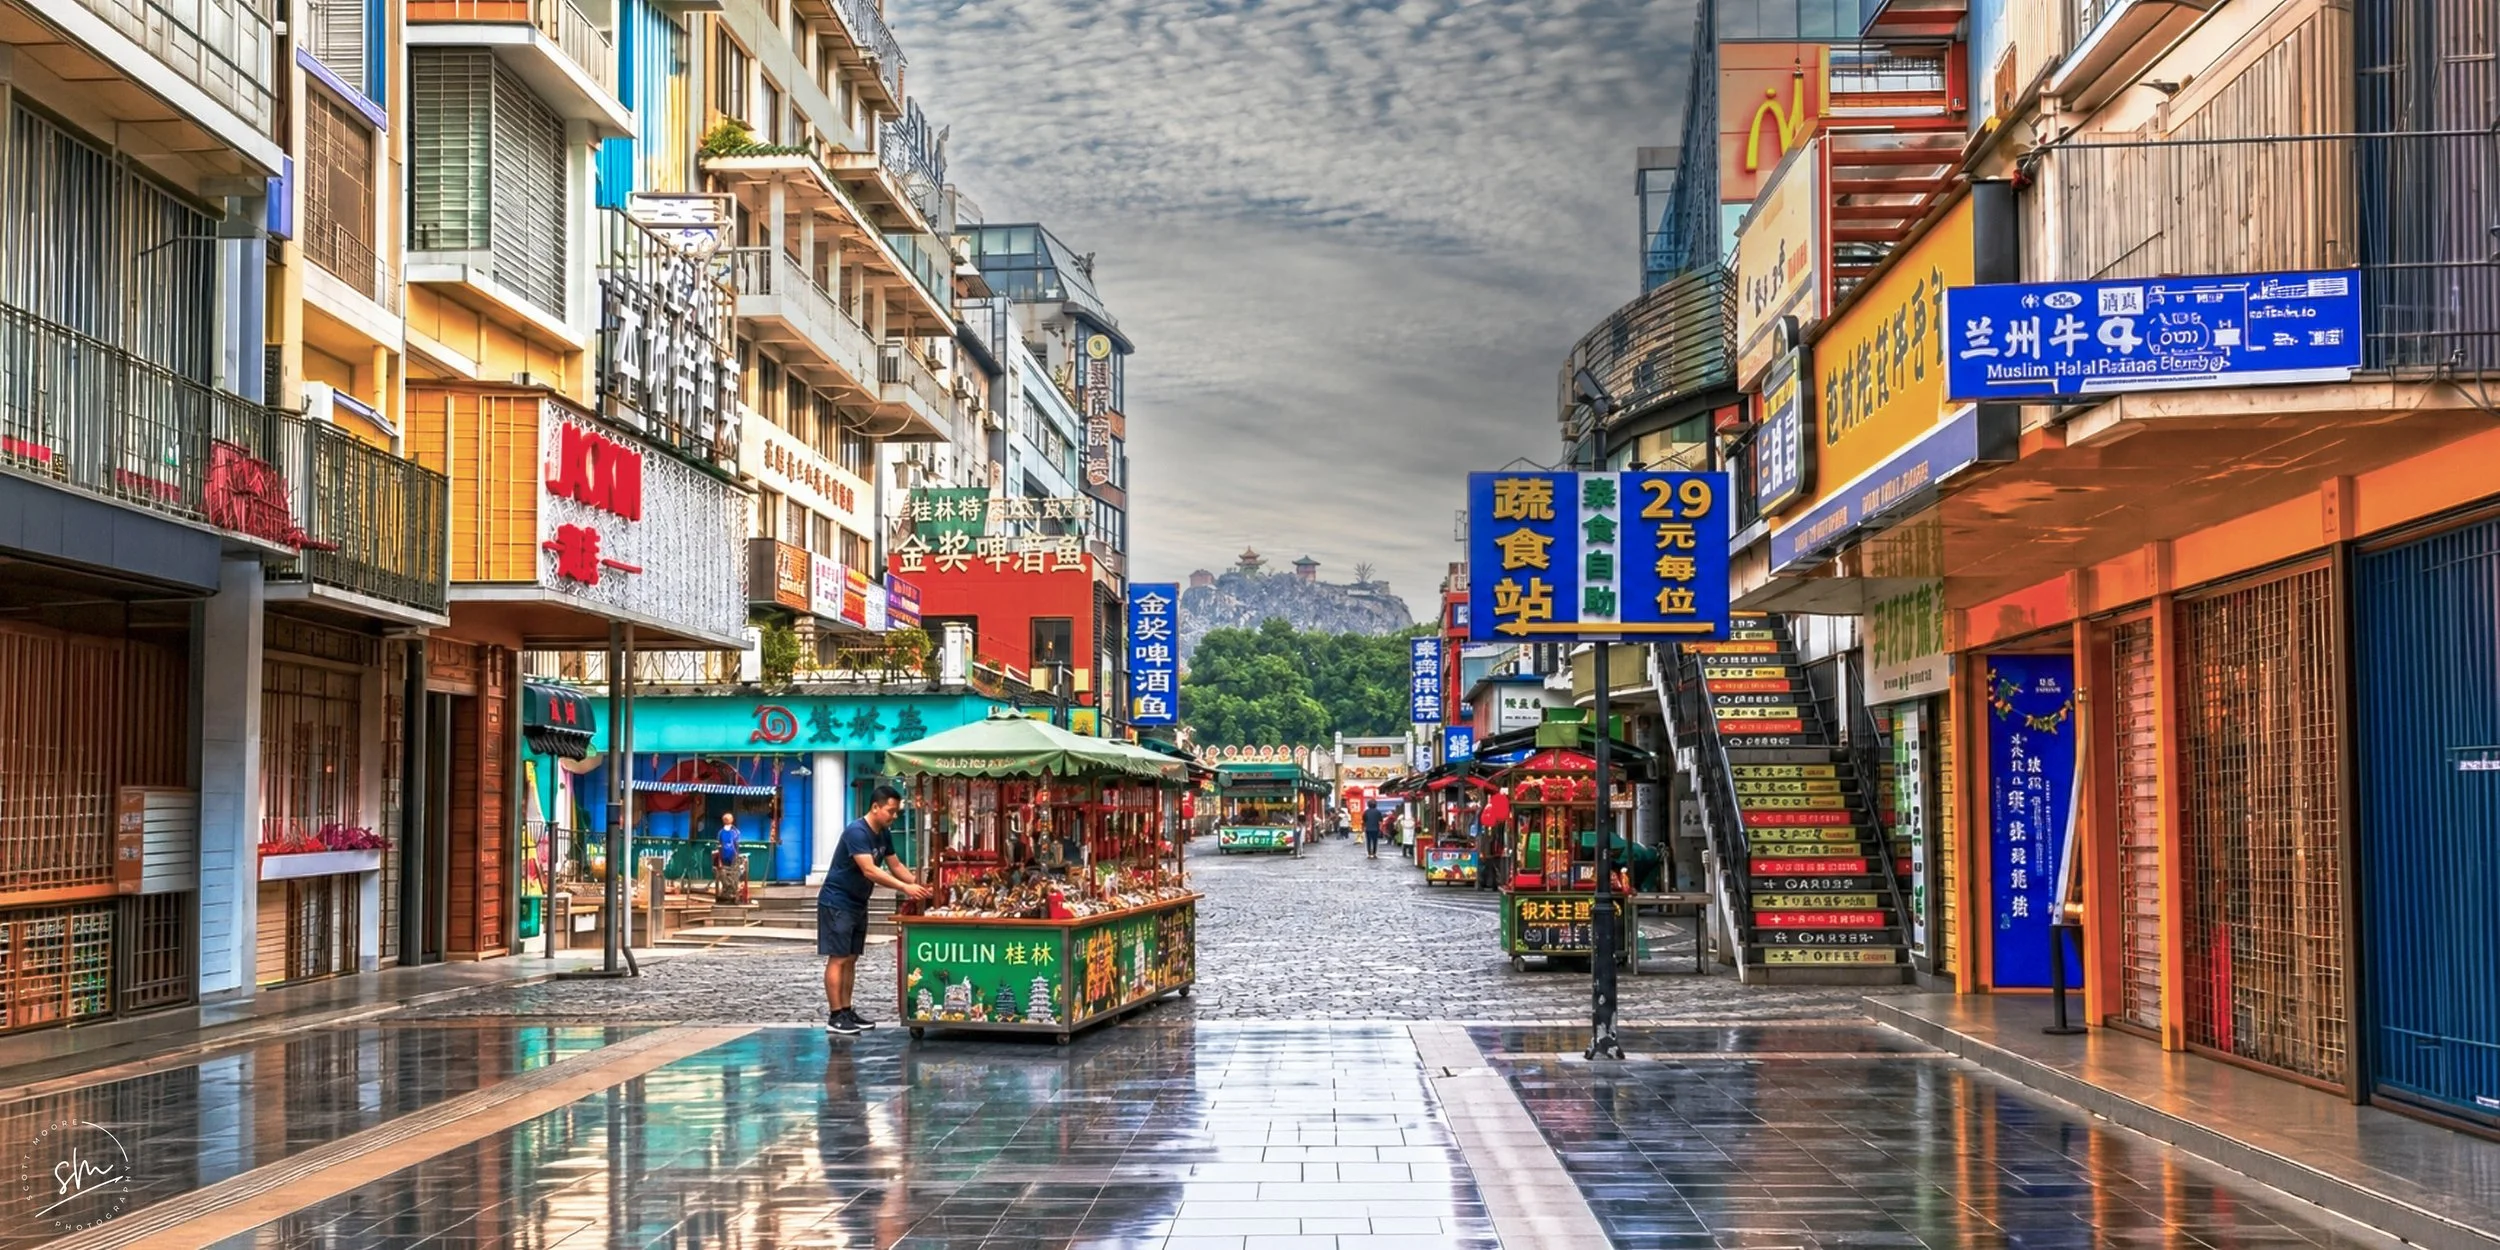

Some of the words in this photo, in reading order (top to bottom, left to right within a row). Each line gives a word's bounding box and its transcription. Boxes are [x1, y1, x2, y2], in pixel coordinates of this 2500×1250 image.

[1986, 361, 2049, 379] Muslim
[2054, 359, 2096, 377] Halal
[1640, 479, 1712, 518] 29
[1493, 477, 1555, 622] 蔬食站
[1582, 477, 1618, 617] 素食自助
[1655, 523, 1697, 615] 元每位
[1133, 591, 1172, 720] 金奖啤酒鱼
[917, 942, 995, 964] GUILIN
[1004, 941, 1054, 967] 桂林
